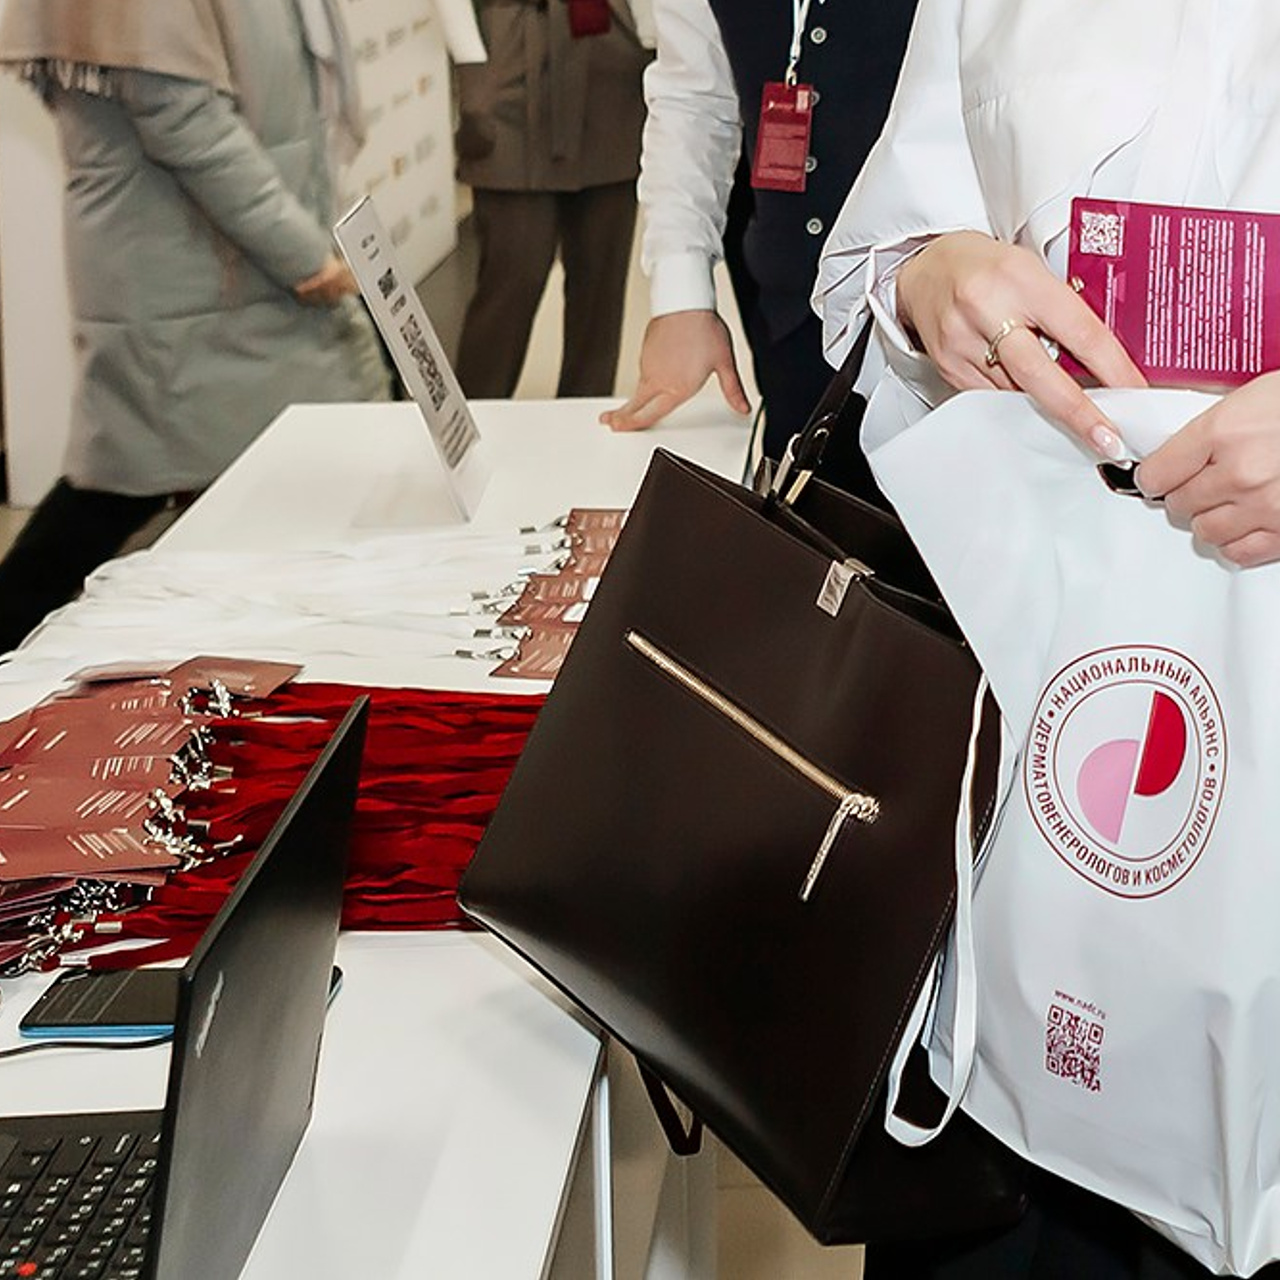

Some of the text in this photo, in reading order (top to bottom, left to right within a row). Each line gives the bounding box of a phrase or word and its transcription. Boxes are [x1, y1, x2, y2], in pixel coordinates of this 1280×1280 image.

[1051, 657, 1219, 758] НАЦИОНАЛЬНЫЙ АЛЬЯНС
[1032, 717, 1217, 887] ДЕРМАТОВЕНЕРОЛОГОВ И КОСМЕТОЛОГОВ
